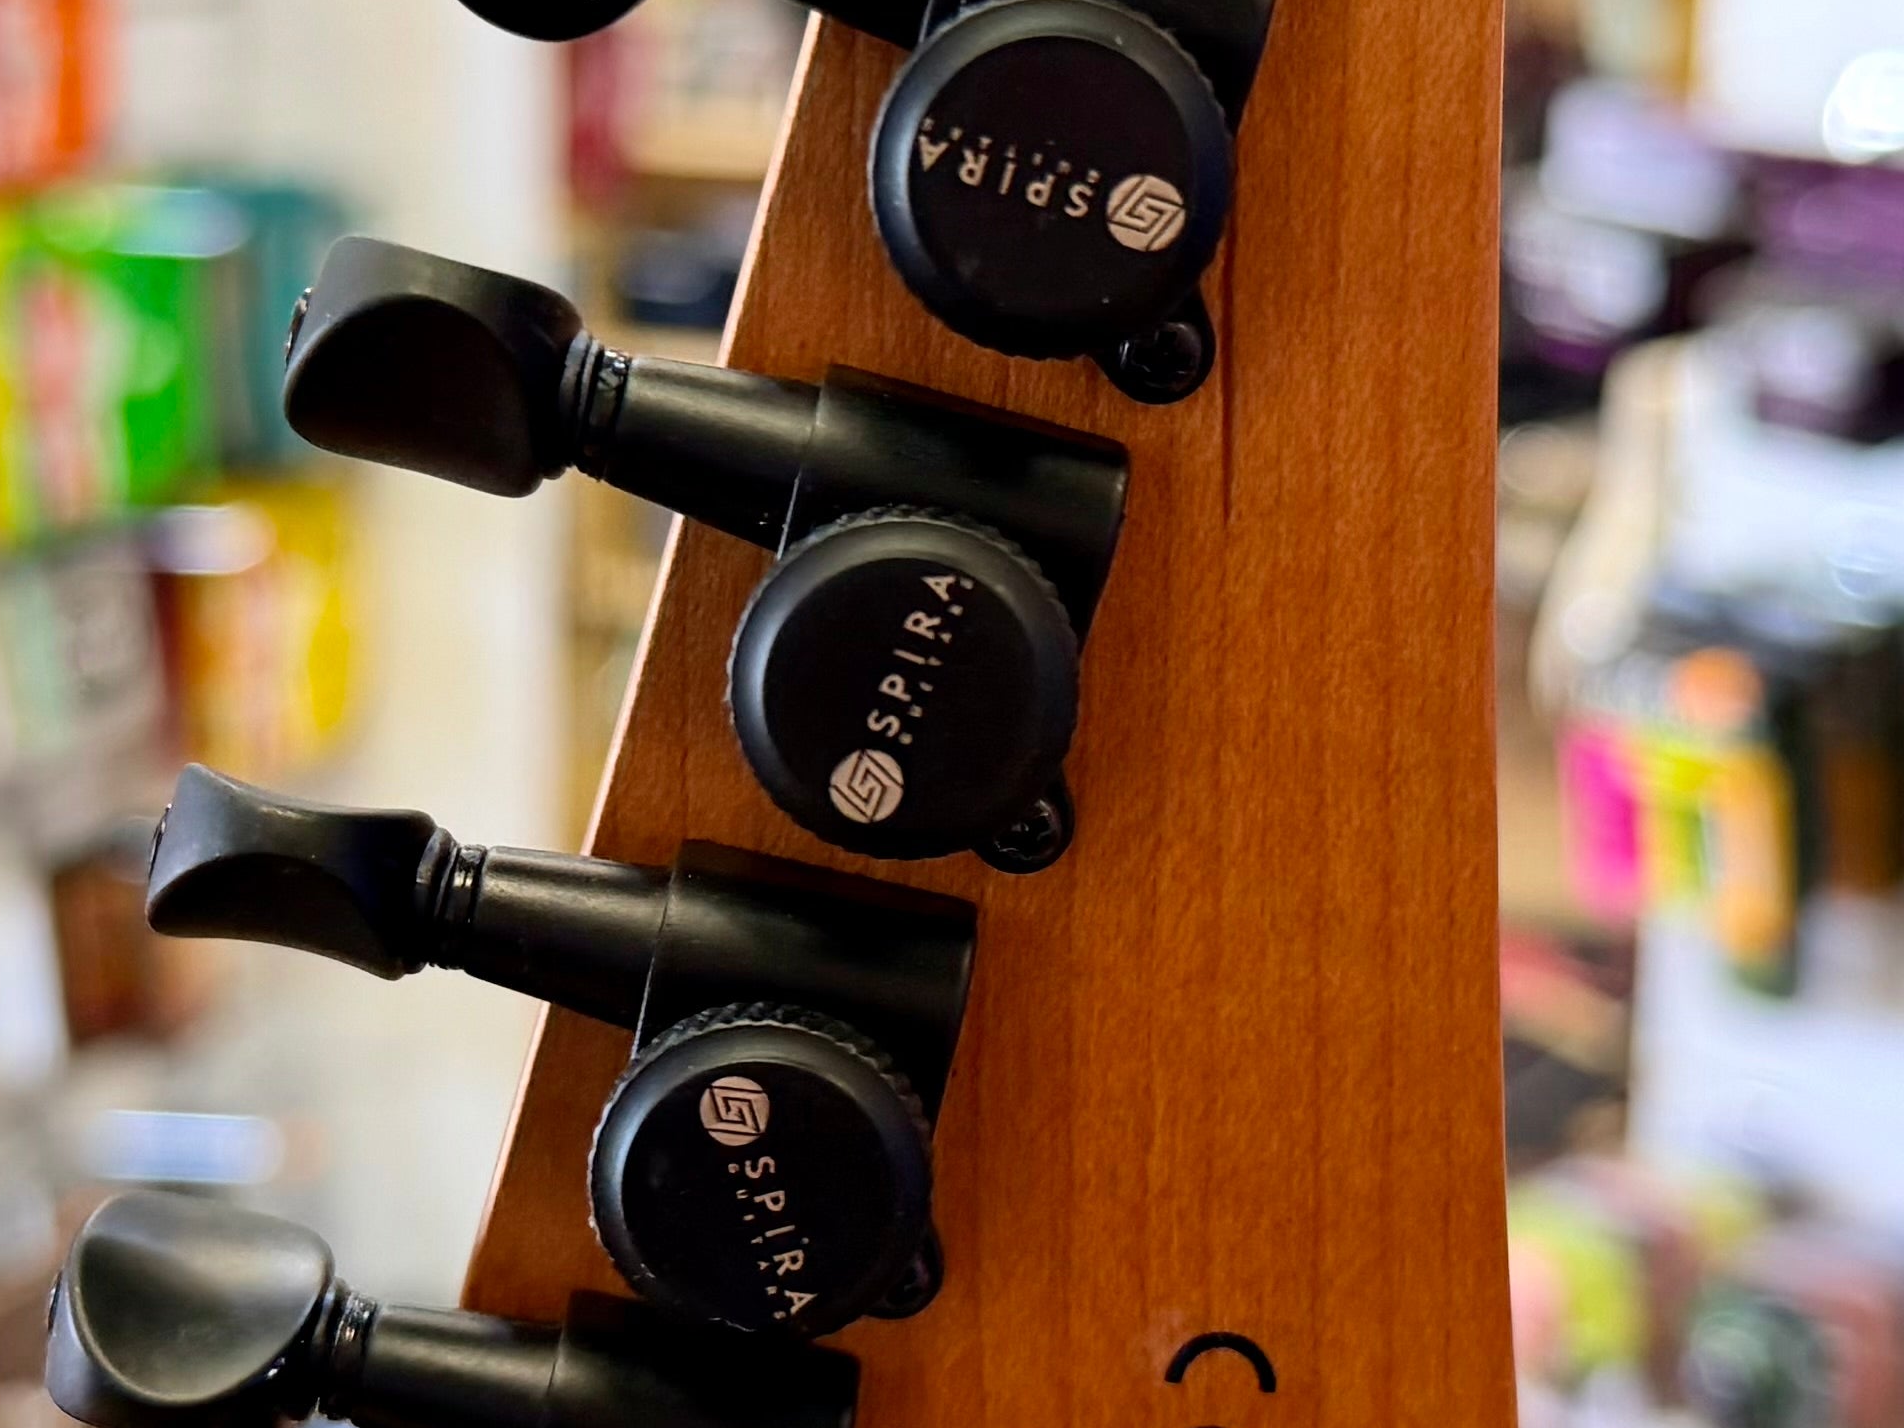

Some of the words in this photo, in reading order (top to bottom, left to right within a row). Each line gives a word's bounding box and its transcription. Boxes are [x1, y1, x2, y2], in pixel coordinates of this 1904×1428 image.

[917, 136, 1093, 218] SPIRA
[867, 574, 957, 738] SPIRA
[745, 1156, 819, 1315] SPIRA
